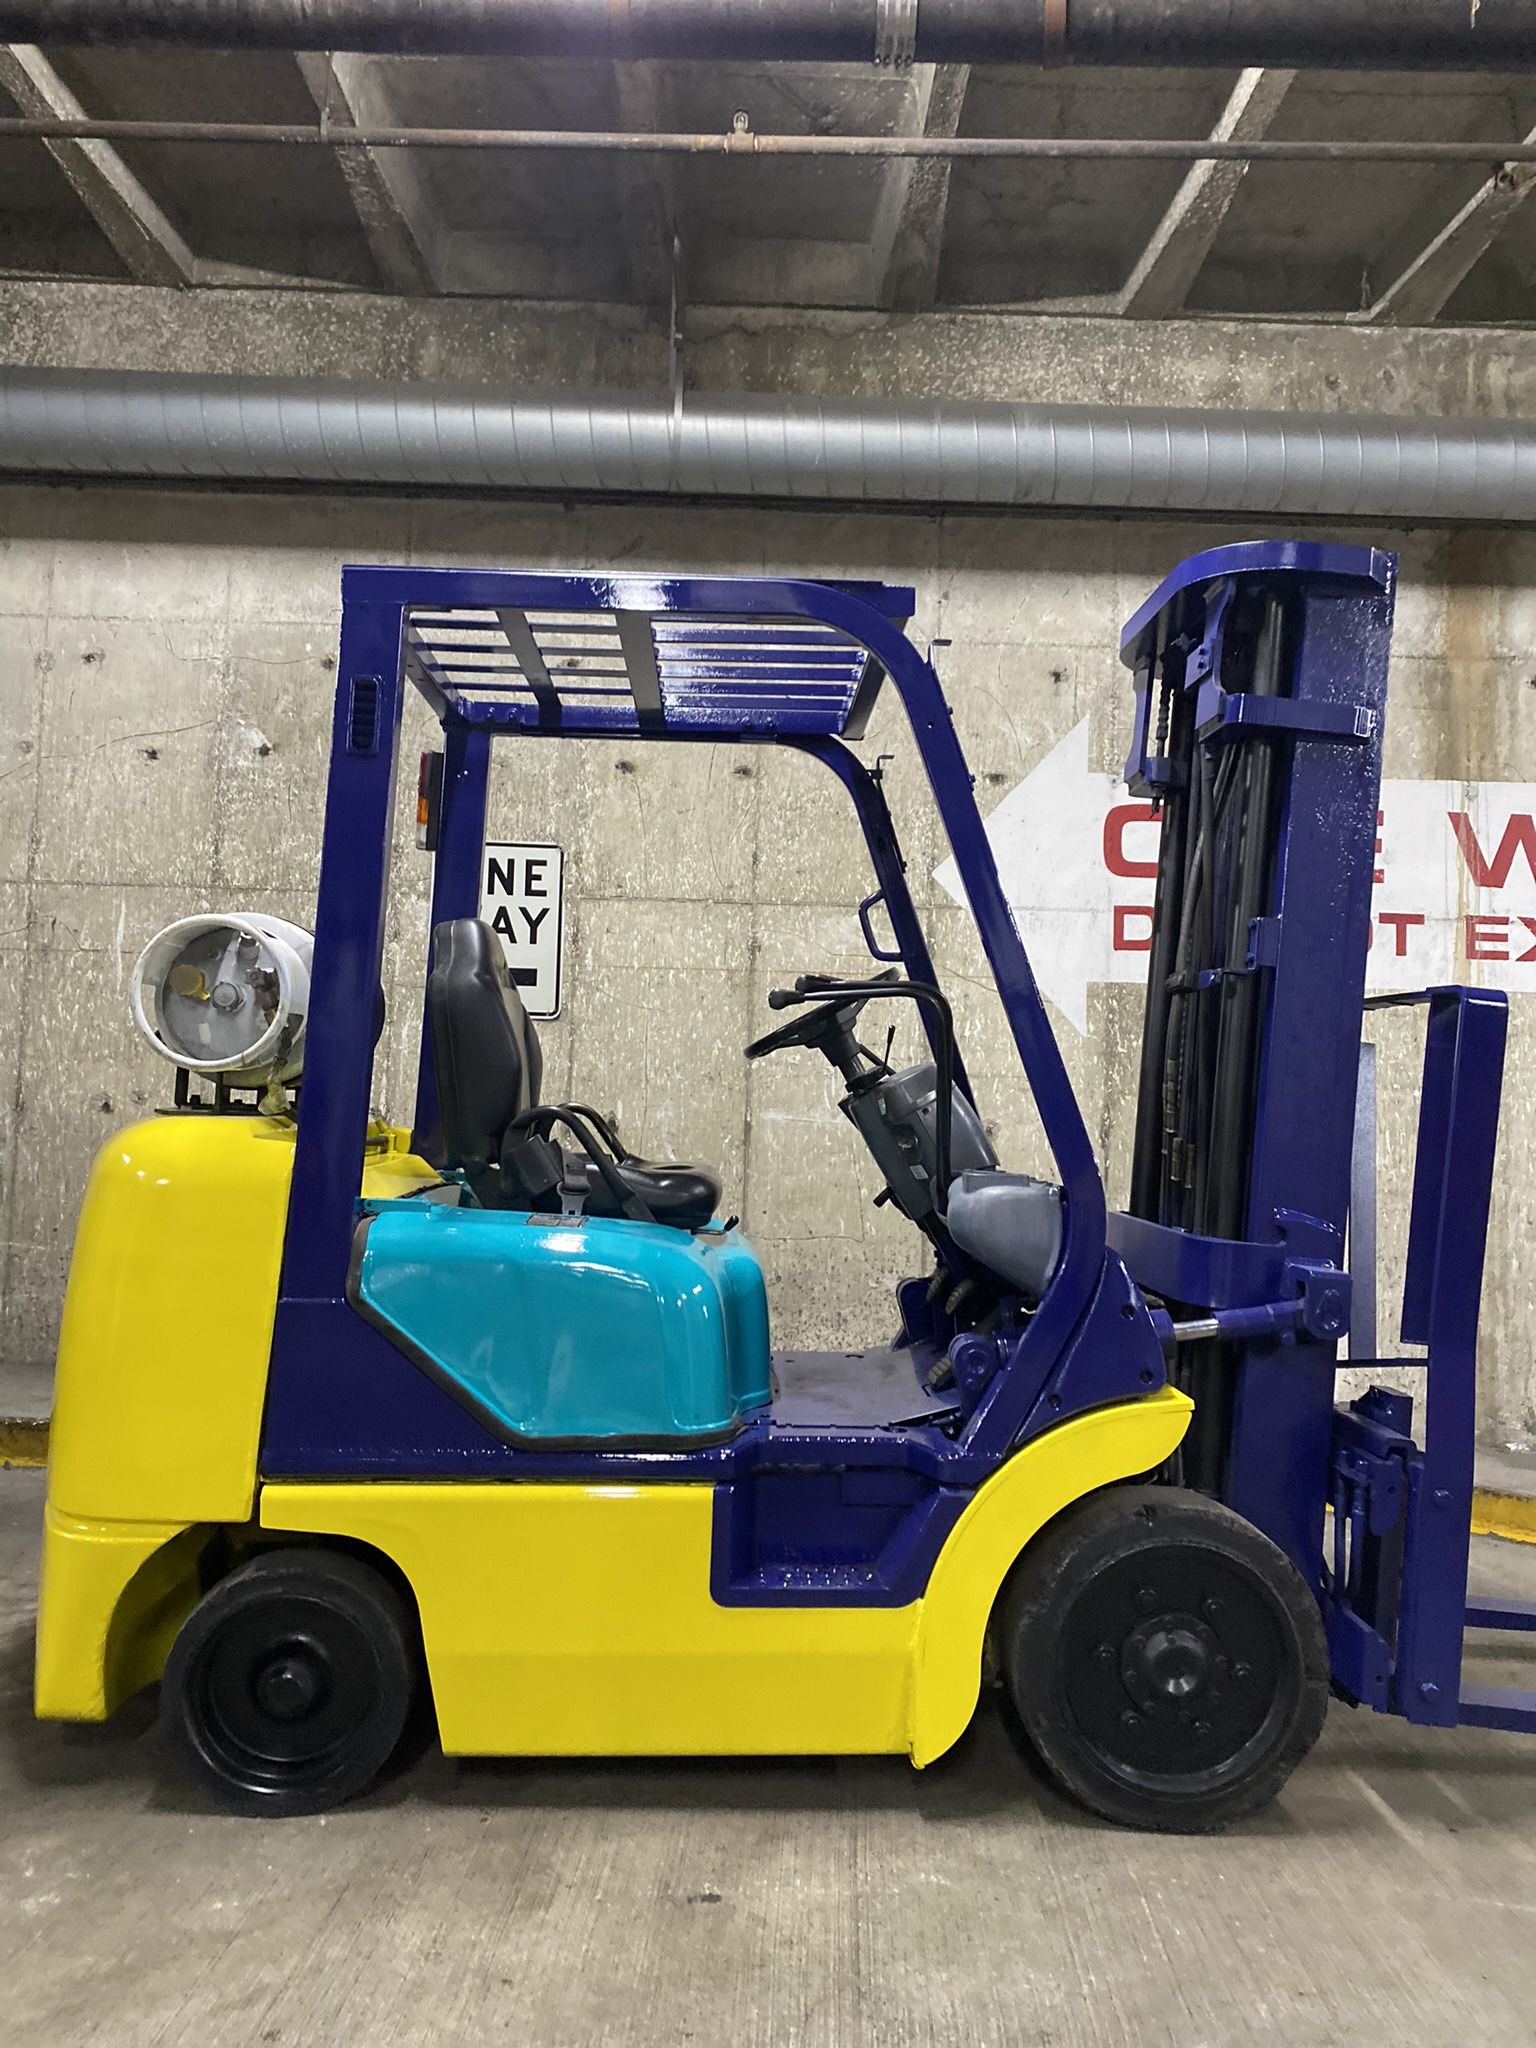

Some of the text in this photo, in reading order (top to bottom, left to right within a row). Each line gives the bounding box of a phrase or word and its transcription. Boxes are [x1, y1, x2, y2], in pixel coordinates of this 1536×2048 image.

[487, 857, 548, 897] NE
[491, 905, 551, 945] AY
[1113, 905, 1156, 951] D
